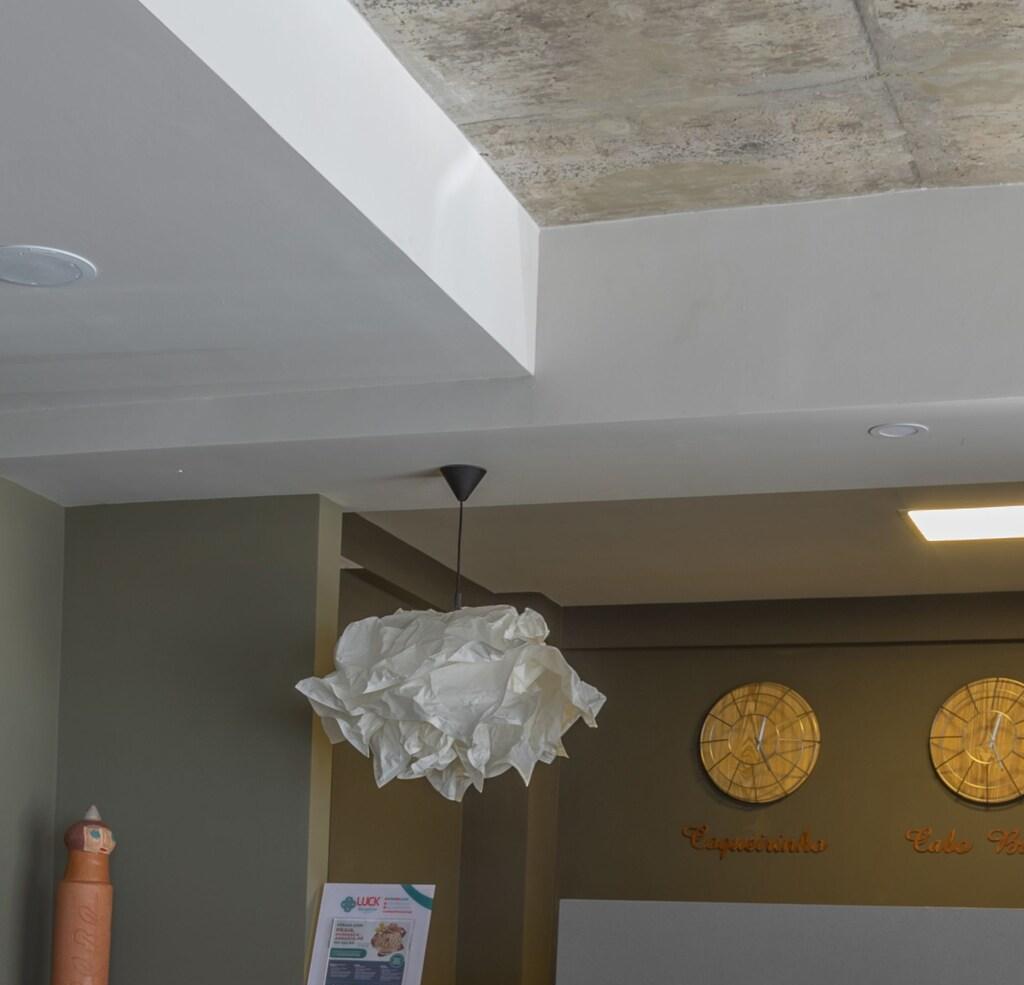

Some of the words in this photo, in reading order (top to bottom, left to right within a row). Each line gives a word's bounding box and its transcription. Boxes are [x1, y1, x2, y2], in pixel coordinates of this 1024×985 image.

[682, 825, 828, 860] Coqueirinho
[905, 827, 972, 854] Cabo
[356, 896, 381, 906] LUCK
